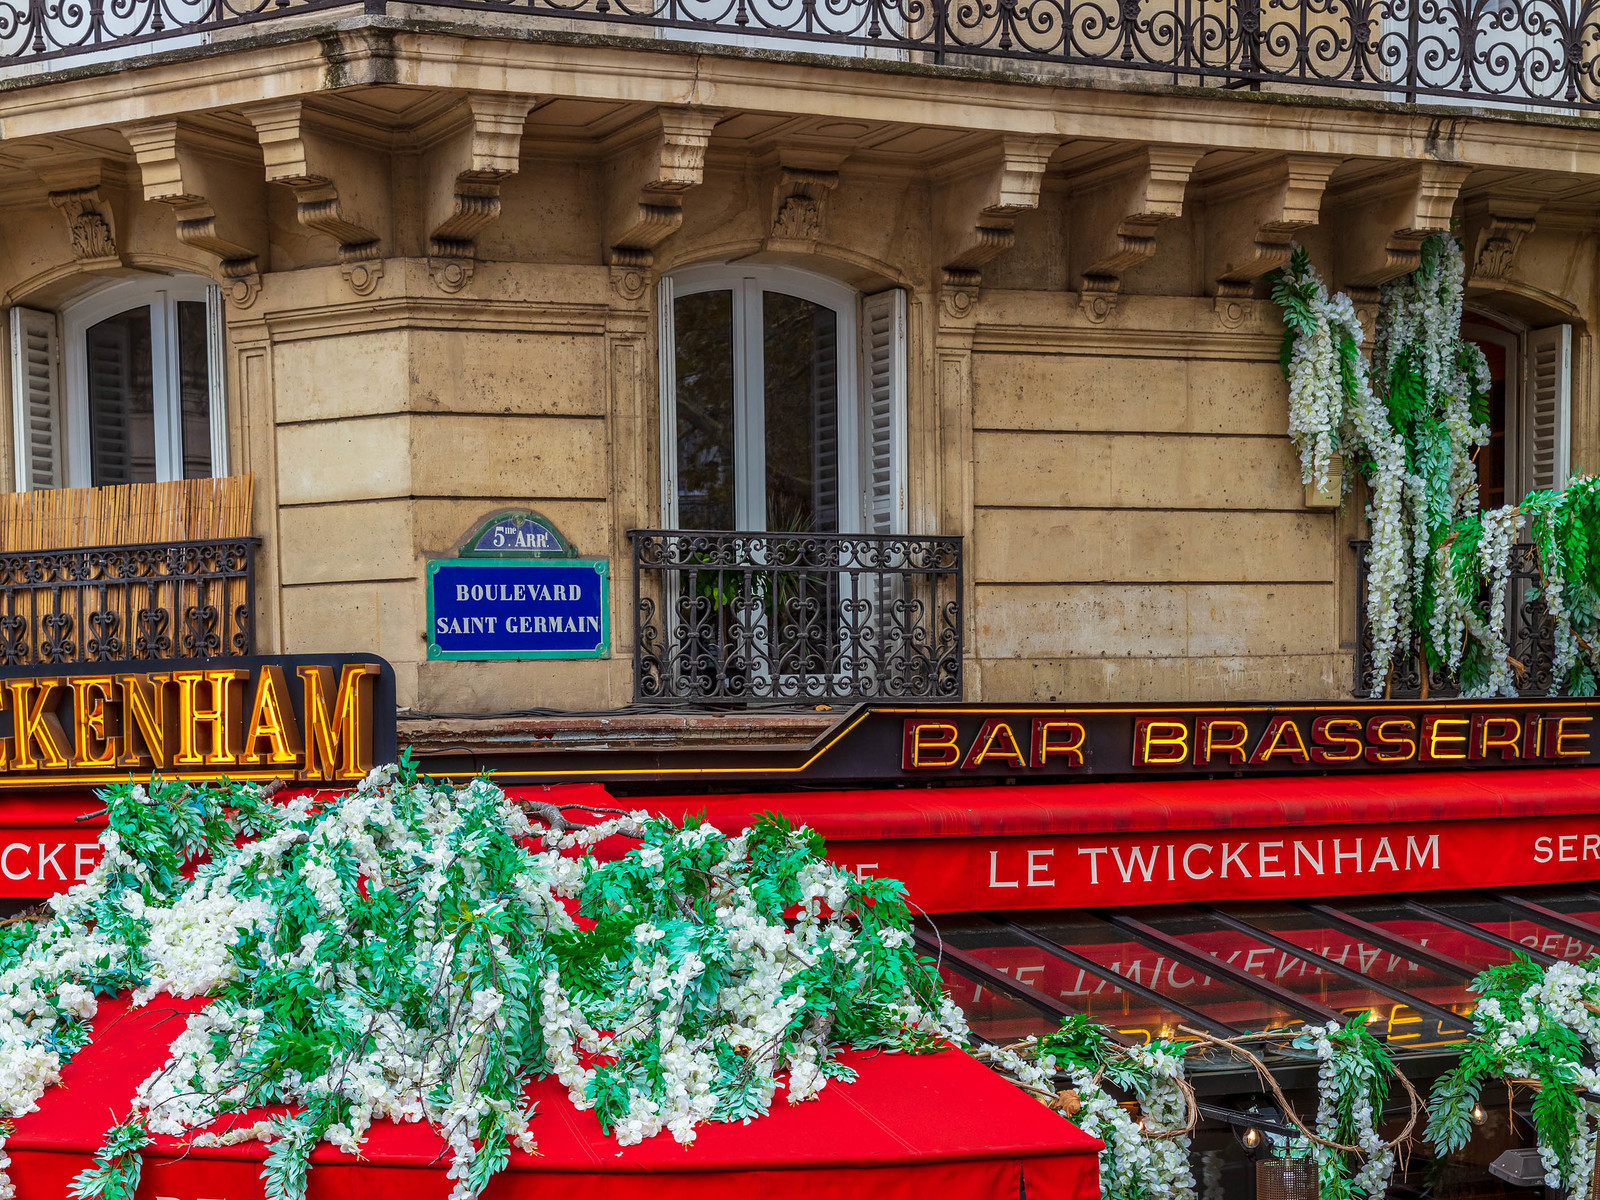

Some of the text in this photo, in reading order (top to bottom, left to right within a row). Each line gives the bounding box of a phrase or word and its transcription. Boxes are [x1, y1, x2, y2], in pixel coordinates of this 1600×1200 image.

[456, 584, 582, 601] BOULEVARD
[437, 616, 599, 634] SAINT GERMAIN
[902, 712, 1594, 769] BAR BRASSERIE
[988, 848, 1056, 889] LE
[1077, 834, 1441, 885] TWICKENHAM
